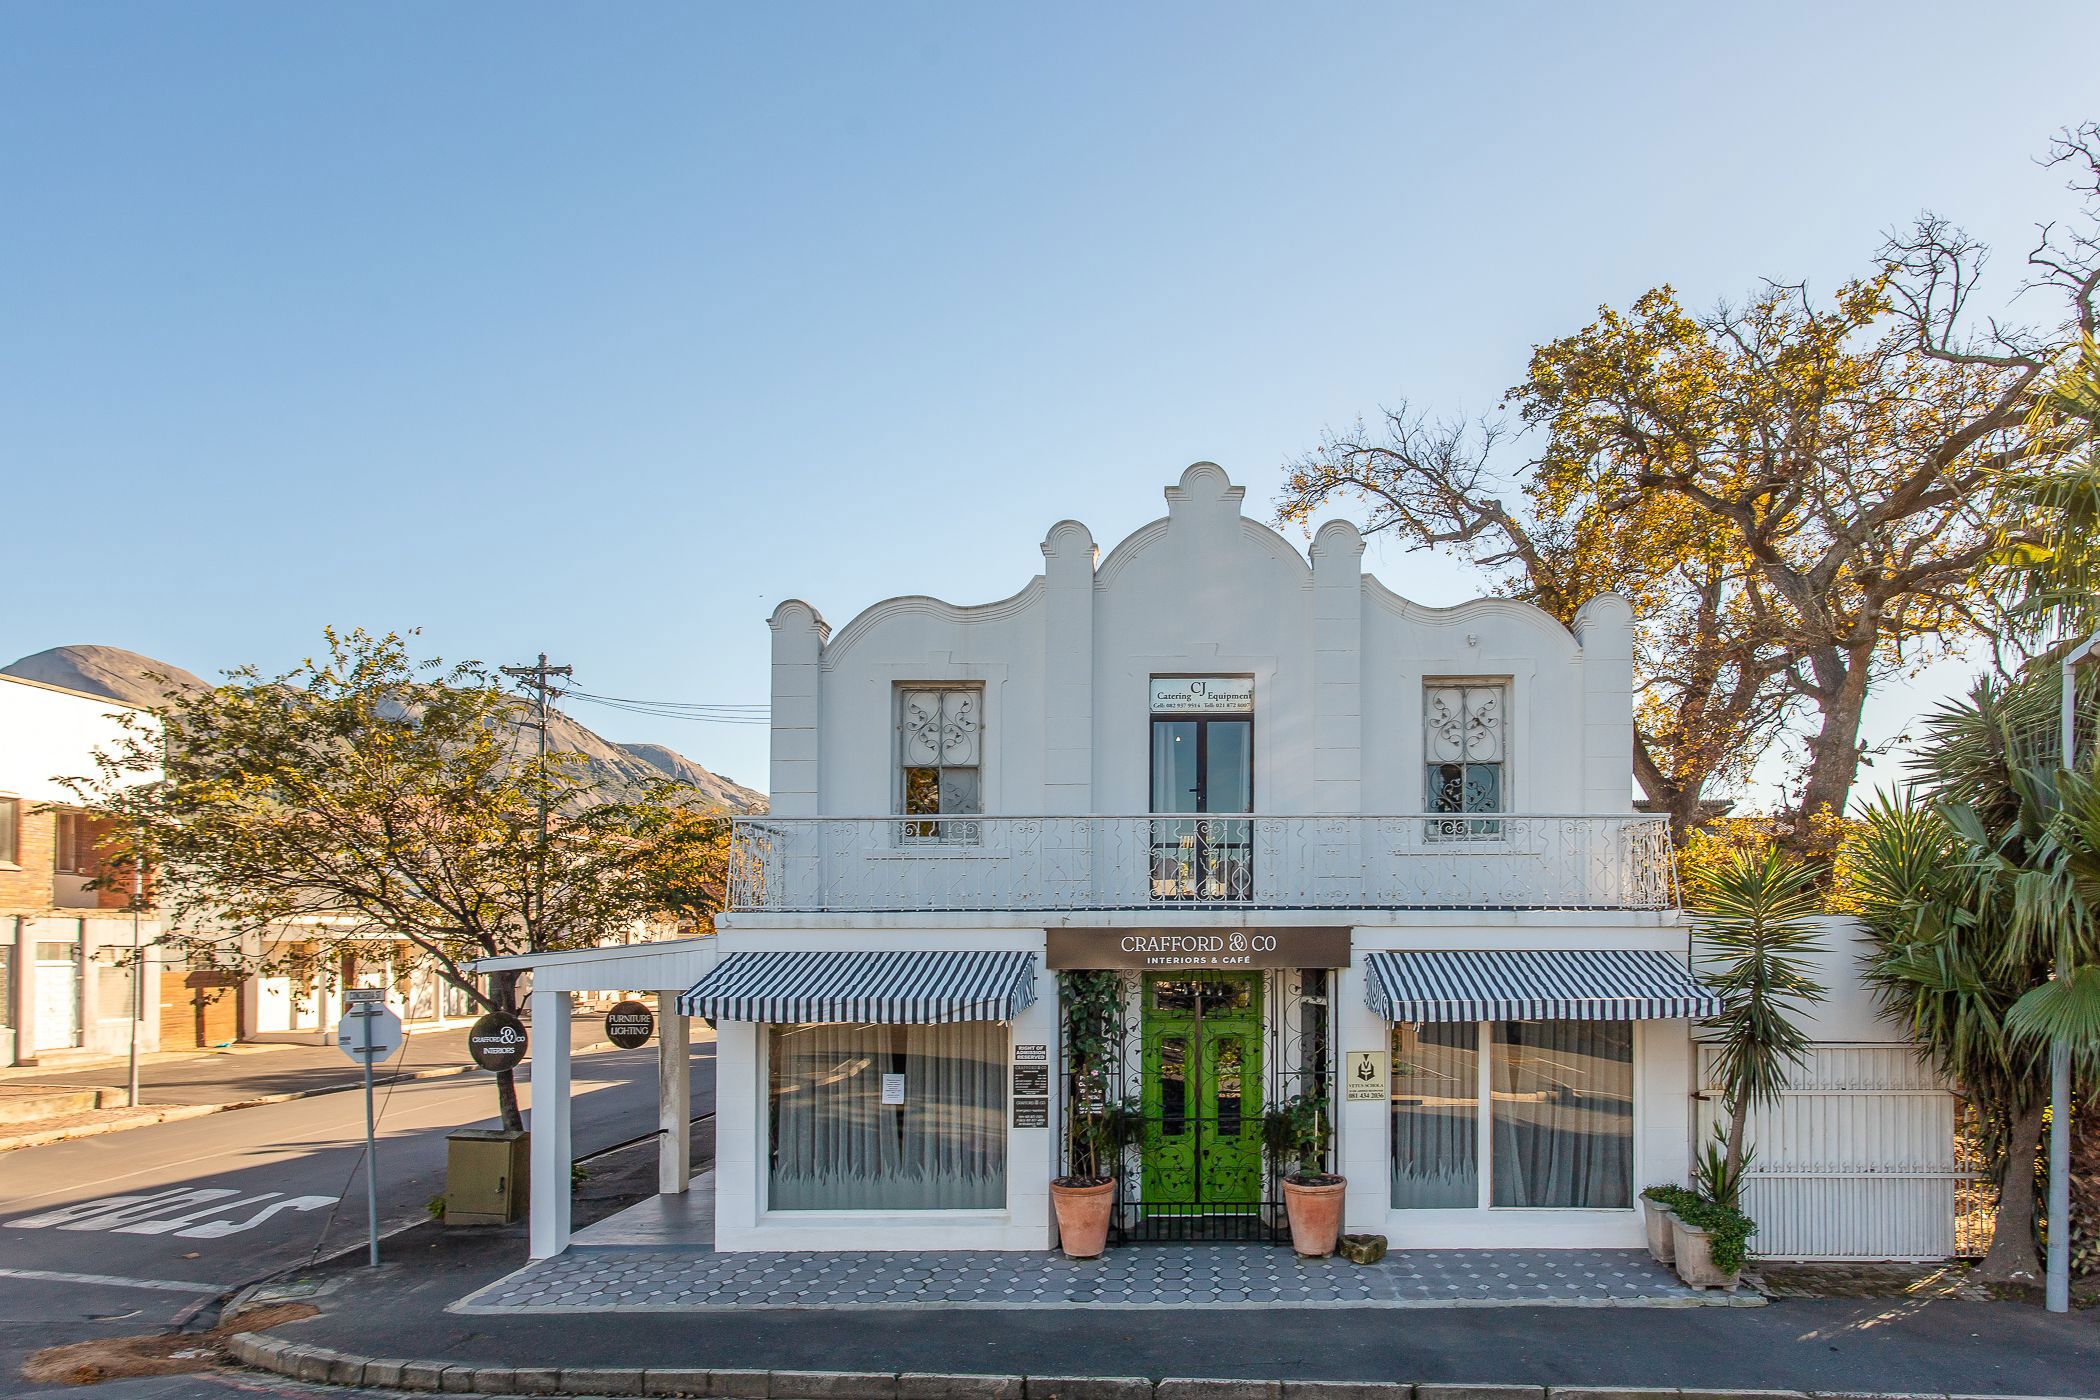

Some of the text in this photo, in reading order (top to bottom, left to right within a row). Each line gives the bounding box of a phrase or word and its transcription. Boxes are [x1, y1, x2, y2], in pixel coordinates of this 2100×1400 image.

[1190, 681, 1207, 697] CJ
[1157, 691, 1252, 702] Catering Equipment
[1121, 931, 1277, 952] CRAFFORD & CO
[1222, 955, 1251, 964] CAFÉ
[608, 1014, 652, 1023] FURNITURE
[500, 1026, 517, 1044] &
[610, 1026, 649, 1035] LIGHTING
[2, 1187, 341, 1239] STOP
